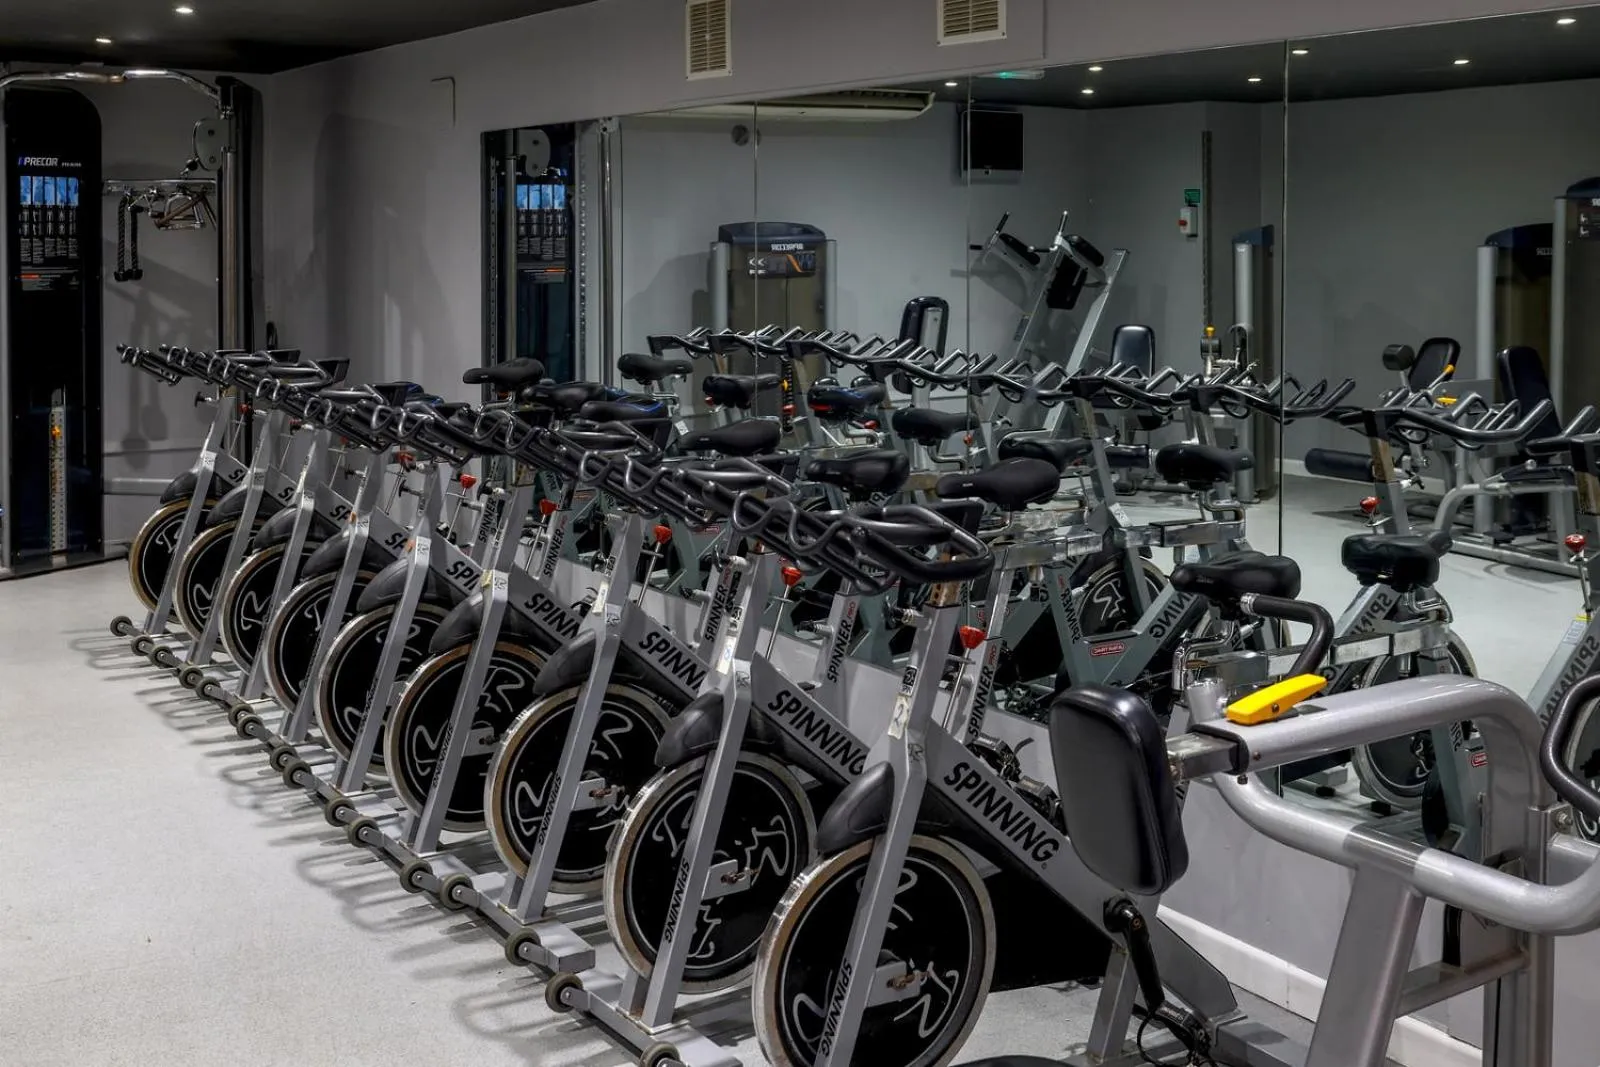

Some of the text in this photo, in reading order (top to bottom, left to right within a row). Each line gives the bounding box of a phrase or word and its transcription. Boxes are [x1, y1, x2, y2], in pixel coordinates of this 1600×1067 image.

[23, 156, 59, 167] PRECOR
[478, 498, 498, 544] SPINNER
[543, 528, 566, 578] SPINNER
[704, 584, 729, 643] SPINNER
[826, 620, 853, 683] SPINNER
[767, 690, 869, 776] SPINNING
[967, 664, 994, 737] SPINNER
[538, 769, 562, 846] SPINNING
[943, 762, 1060, 863] SPINNING
[664, 857, 691, 944] SPINNING
[820, 957, 853, 1058] SPINNING
